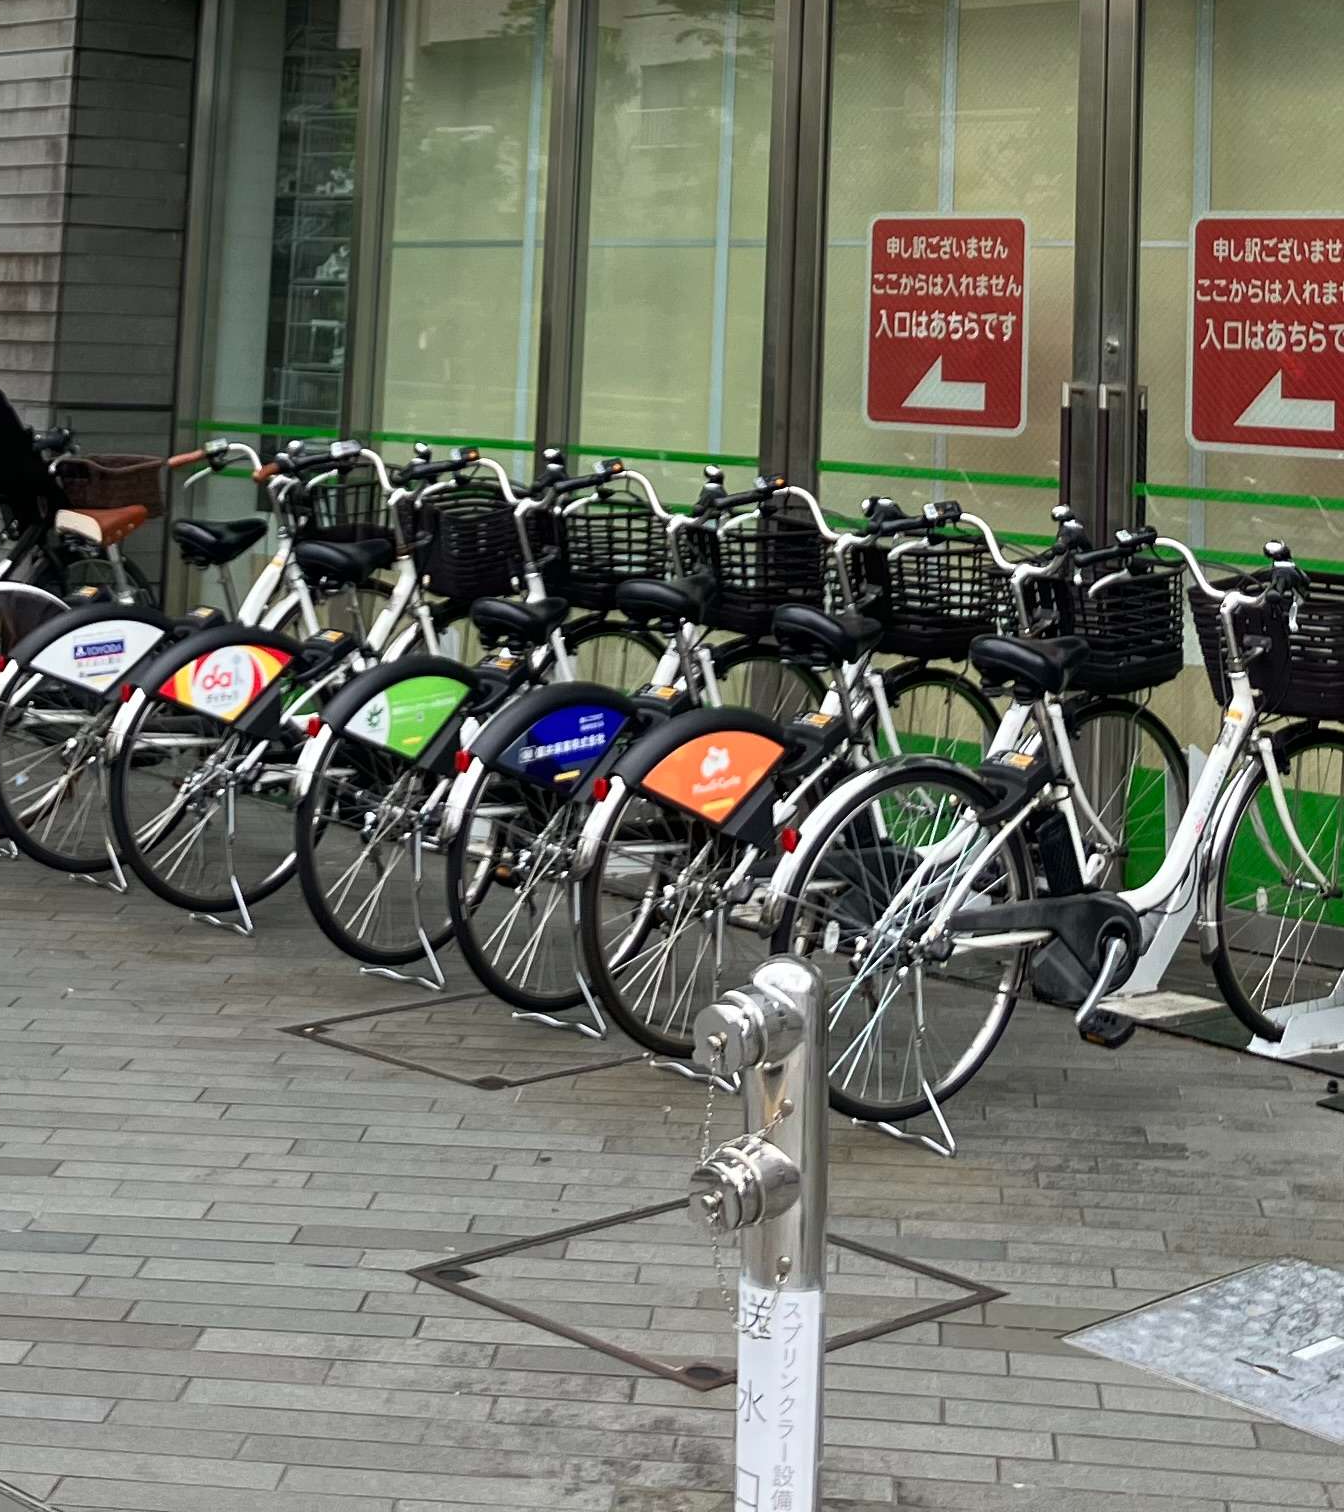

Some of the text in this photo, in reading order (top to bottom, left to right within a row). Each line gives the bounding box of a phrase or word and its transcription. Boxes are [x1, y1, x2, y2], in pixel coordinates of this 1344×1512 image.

[885, 235, 1009, 261] 申し訳ございません
[871, 272, 1023, 299] ここからは入れません
[874, 310, 1018, 343] 入口はあちらです
[769, 1301, 804, 1511] スプリンクラー設備
